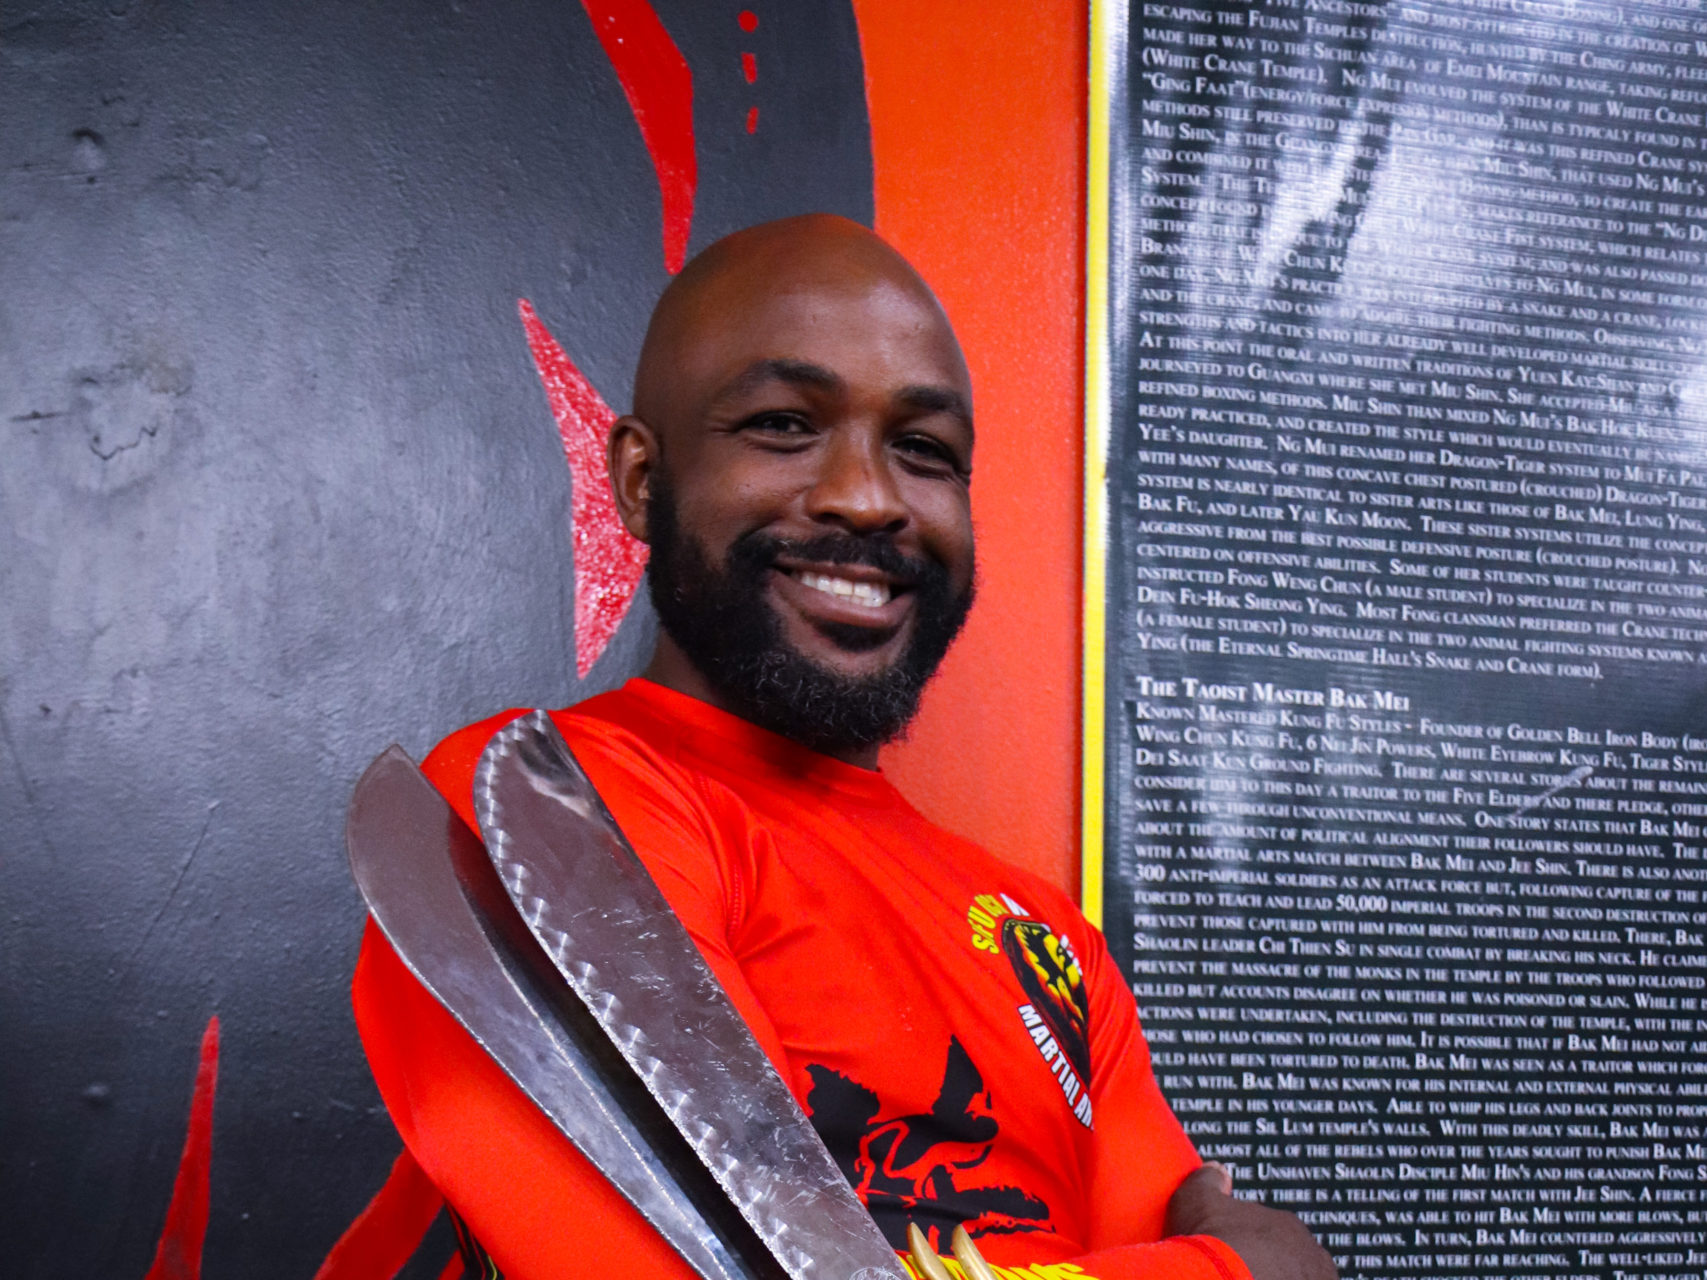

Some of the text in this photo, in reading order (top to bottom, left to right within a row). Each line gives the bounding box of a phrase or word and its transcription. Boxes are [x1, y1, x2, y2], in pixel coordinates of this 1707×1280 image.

[1140, 423, 1621, 480] YEE'S DAUGHTER. NG MUI RENAMED HER DRAGON-TIGER SYSTEM TO
[1139, 632, 1602, 678] YING (THE ETERNAL SPRINGTIME HALL'S SNAKE AND CRANE FORM).
[1137, 675, 1410, 710] THE TAOIST MASTER BAK MEI
[1136, 701, 1195, 719] KNOWN
[1279, 709, 1322, 728] KUNG
[1324, 712, 1345, 729] FU
[1348, 713, 1402, 732] STYLES
[1419, 717, 1483, 737] FOUNDER
[1485, 726, 1503, 739] OF
[1506, 723, 1563, 741] GOLDEN
[1567, 726, 1601, 744] BELL
[1605, 729, 1637, 745] IRON
[1641, 731, 1678, 748] BODY
[1133, 863, 1166, 881] 300
[1274, 873, 1337, 887] SOLDIERS
[1340, 876, 1358, 888] AS
[1362, 877, 1381, 889] AN
[1385, 877, 1437, 891] ATTACK
[1440, 879, 1481, 893] FORCE
[1485, 881, 1515, 896] BUT,
[1519, 883, 1593, 897] FOLLOWING
[1595, 886, 1651, 900] CAPTURE
[1654, 889, 1671, 901] OF
[1675, 889, 1698, 902] THE
[1133, 888, 1689, 922] FORCED TO TEACH AND LEAD 50,000 IMPERIAL TROOPS IN THE SECOND DESTRUCTION
[1017, 1003, 1081, 1107] MARTIAL
[1183, 1117, 1700, 1138] LONG THE SIL LUM TEMPLE'S WALLS. WITH THIS DEADLY SKILL, BAK MEI WAS
[1226, 1162, 1693, 1180] THE UNSHAVEN SHAOLIN DISCIPLE MIU HIN'S AND HIS GRANDSON FONG
